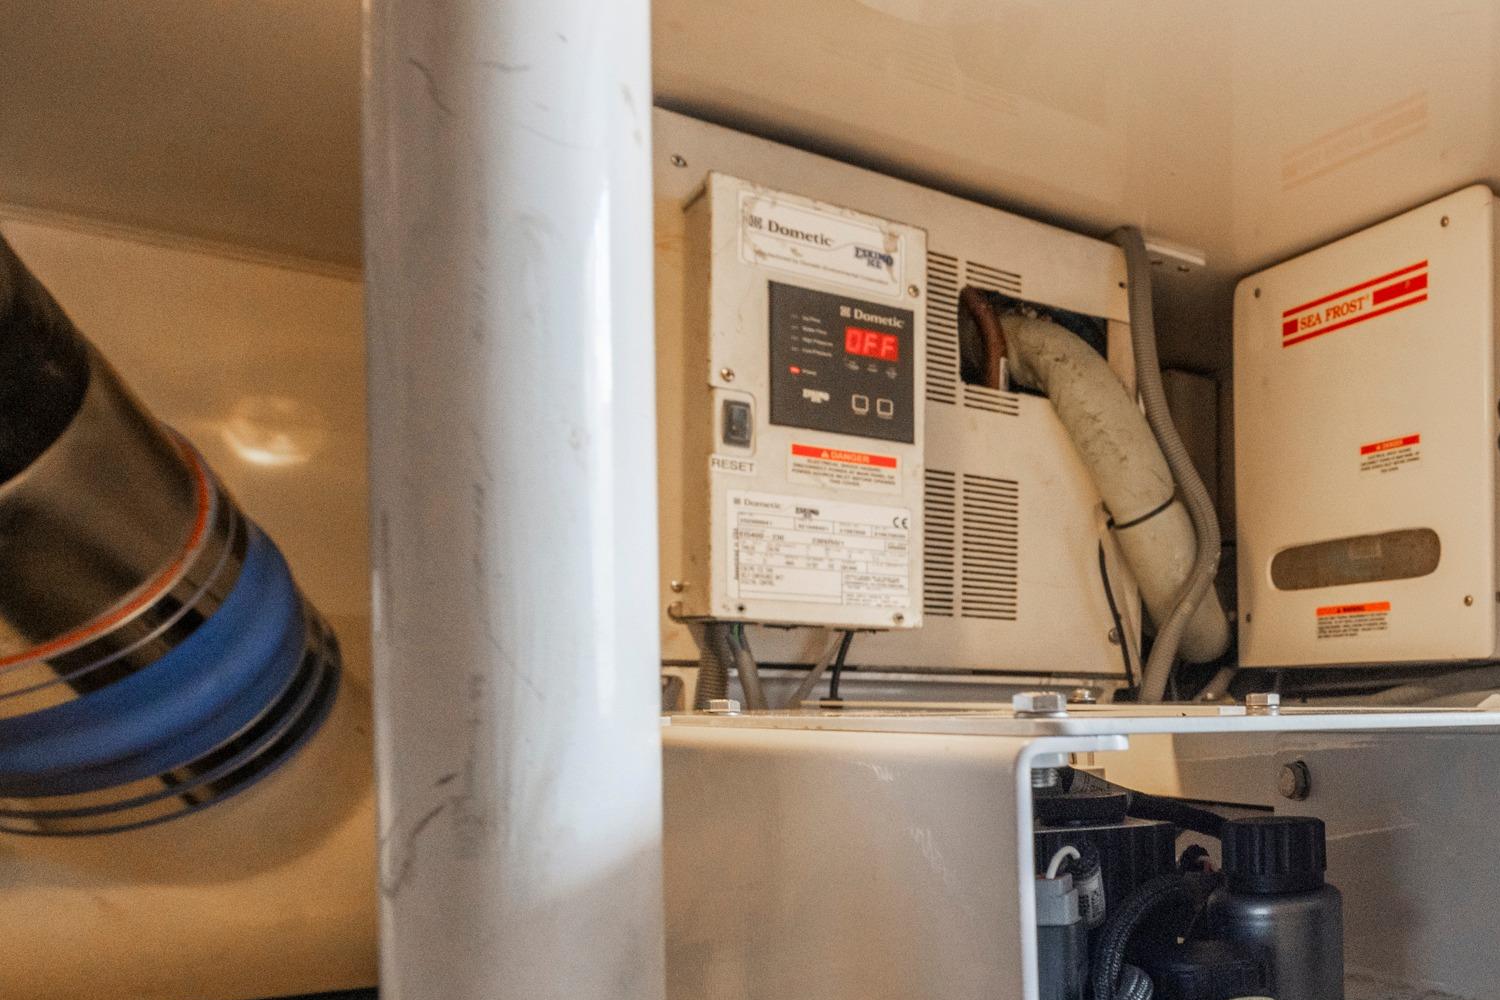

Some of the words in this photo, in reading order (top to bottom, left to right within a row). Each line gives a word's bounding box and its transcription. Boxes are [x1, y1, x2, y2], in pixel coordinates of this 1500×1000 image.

[768, 219, 832, 247] Dometic
[854, 308, 903, 328] Dometic
[1299, 313, 1322, 330] SEA
[1324, 296, 1365, 322] FROST
[846, 327, 897, 359] OFF
[711, 457, 755, 473] RESET
[831, 451, 869, 463] DANGER
